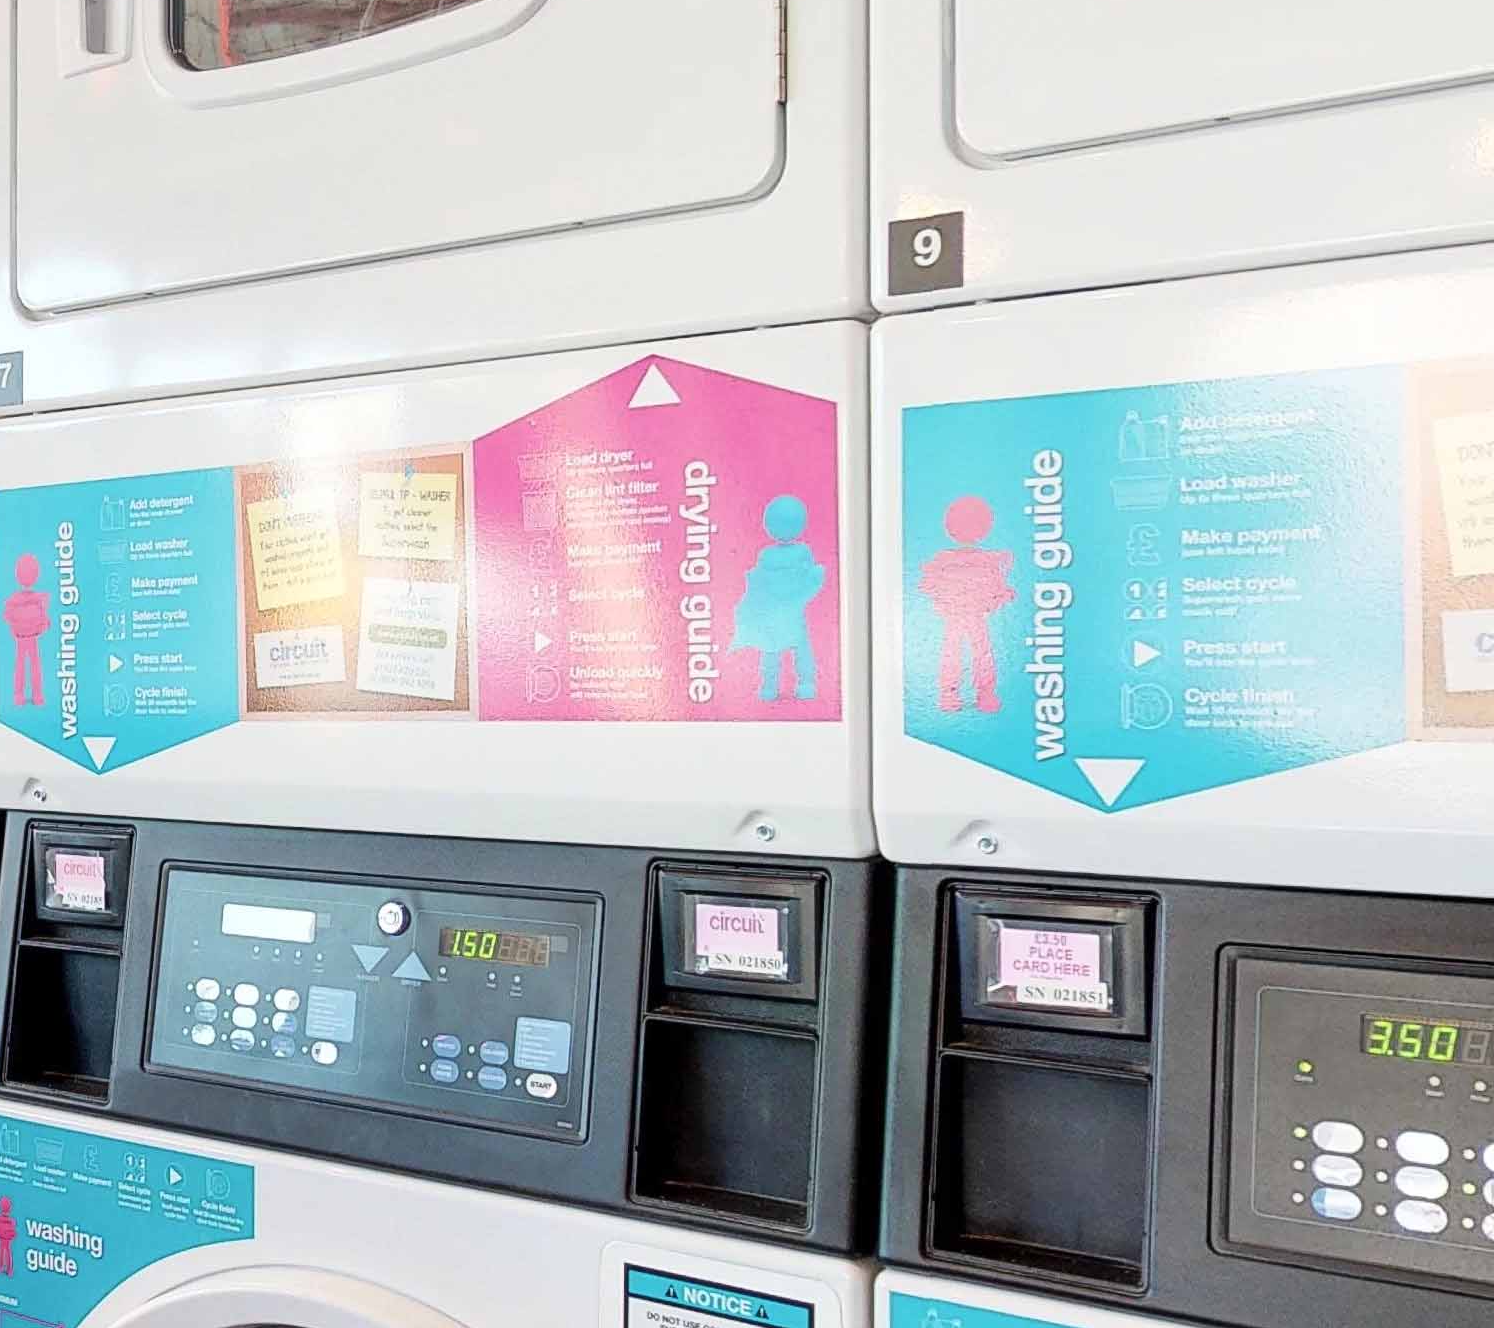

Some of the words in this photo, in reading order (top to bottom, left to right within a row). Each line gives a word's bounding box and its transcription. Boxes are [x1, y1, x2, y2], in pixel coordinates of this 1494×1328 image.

[913, 228, 942, 268] 9
[1180, 475, 1228, 493] Load
[1231, 470, 1303, 488] washer
[129, 498, 148, 510] Add
[149, 493, 194, 509] detergent
[1023, 448, 1074, 571] guide
[678, 460, 718, 584] drying
[130, 540, 153, 553] Load
[155, 537, 189, 550] washer
[1181, 528, 1232, 546] Make
[1237, 525, 1322, 547] payment
[54, 521, 79, 606] guide
[131, 576, 156, 589] Make
[157, 572, 198, 590] payment
[1182, 576, 1241, 593] Select
[1245, 575, 1297, 592] cycle
[132, 610, 161, 622] Select
[162, 609, 187, 622] cycle
[269, 636, 329, 662] circuit
[678, 594, 720, 705] guide
[1183, 640, 1238, 655] Press
[1241, 639, 1287, 654] start
[133, 653, 160, 665] Press
[160, 652, 183, 664] start
[55, 613, 79, 740] washing
[1024, 579, 1074, 762] washing
[134, 686, 161, 701] Cycle
[161, 685, 188, 699] finish
[1184, 688, 1238, 706] Cycle
[1242, 688, 1294, 704] finish
[709, 911, 766, 934] circuit
[452, 930, 498, 959] 1.50
[1028, 946, 1075, 961] PLACE
[715, 953, 733, 964] SN
[739, 955, 782, 971] 021850
[1012, 959, 1052, 974] CARD
[1053, 963, 1092, 978] HERE
[1024, 985, 1047, 1000] SN
[1053, 988, 1104, 1005] 021851
[1365, 1019, 1459, 1062] 3.50
[529, 1080, 553, 1091] START
[26, 1219, 104, 1258] washing
[26, 1250, 78, 1278] guide
[683, 1286, 753, 1317] NOTICE
